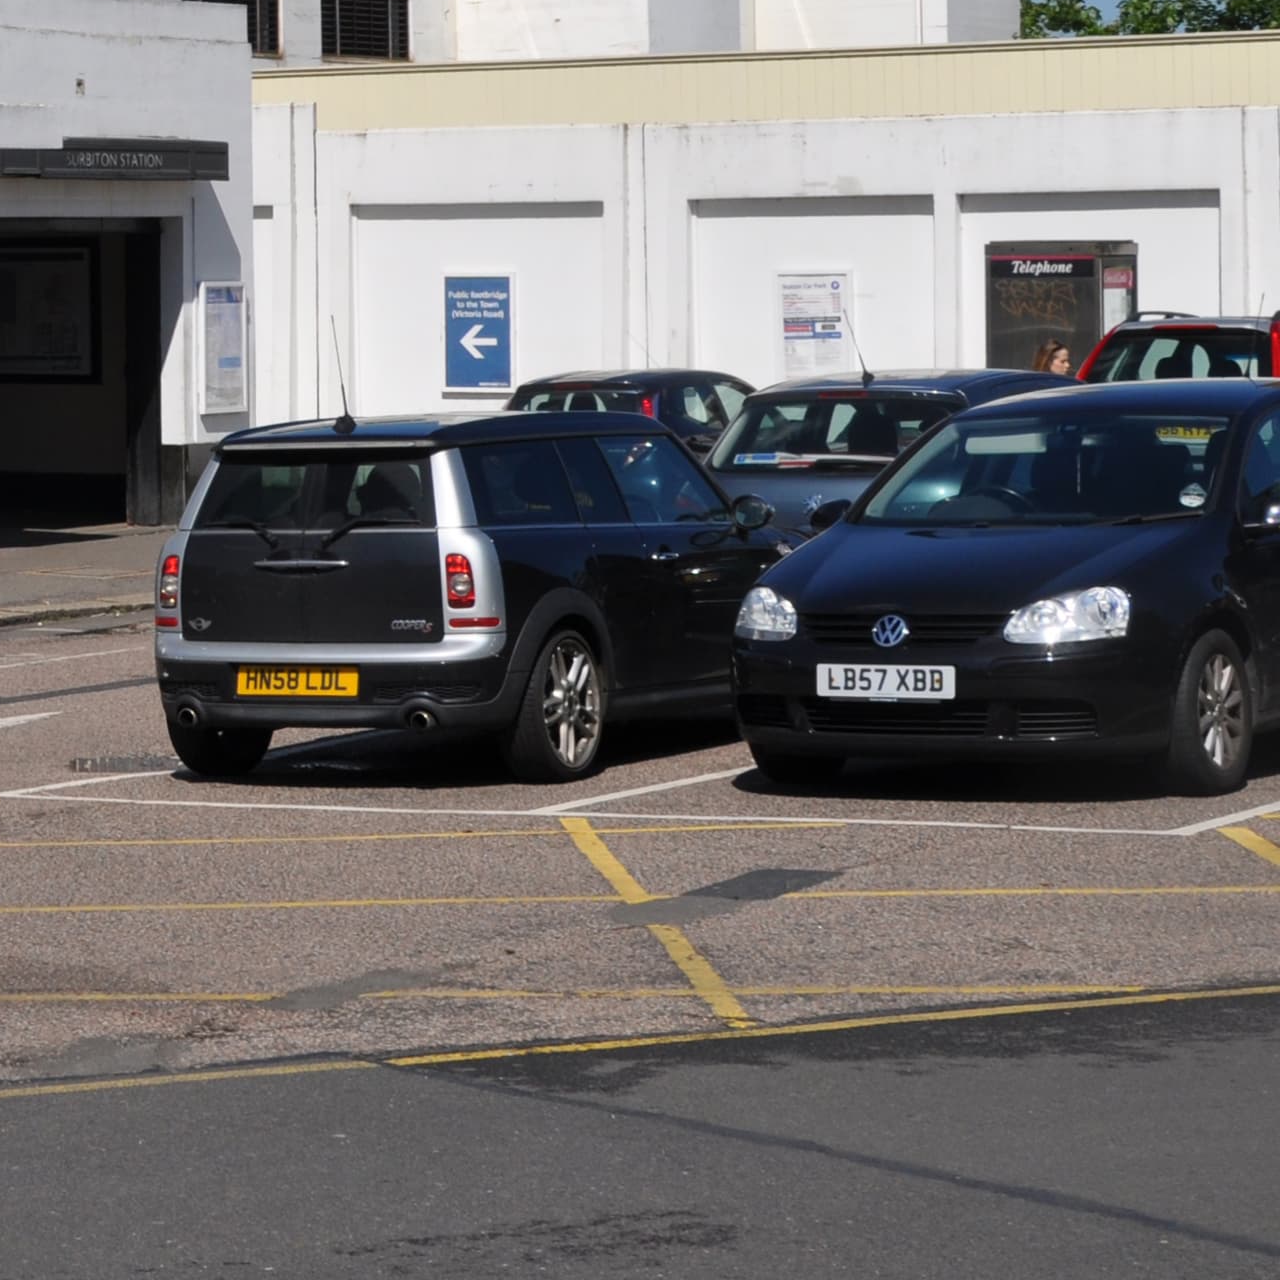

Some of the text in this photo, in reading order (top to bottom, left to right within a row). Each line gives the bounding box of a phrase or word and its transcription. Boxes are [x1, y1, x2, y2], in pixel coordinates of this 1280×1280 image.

[67, 151, 163, 169] SURBITON STATION
[1011, 260, 1073, 276] Telephone
[448, 290, 470, 300] Public
[456, 301, 500, 309] to the Town
[391, 619, 426, 631] COOPER
[245, 669, 348, 691] HN58 LDL
[828, 667, 888, 691] LB57
